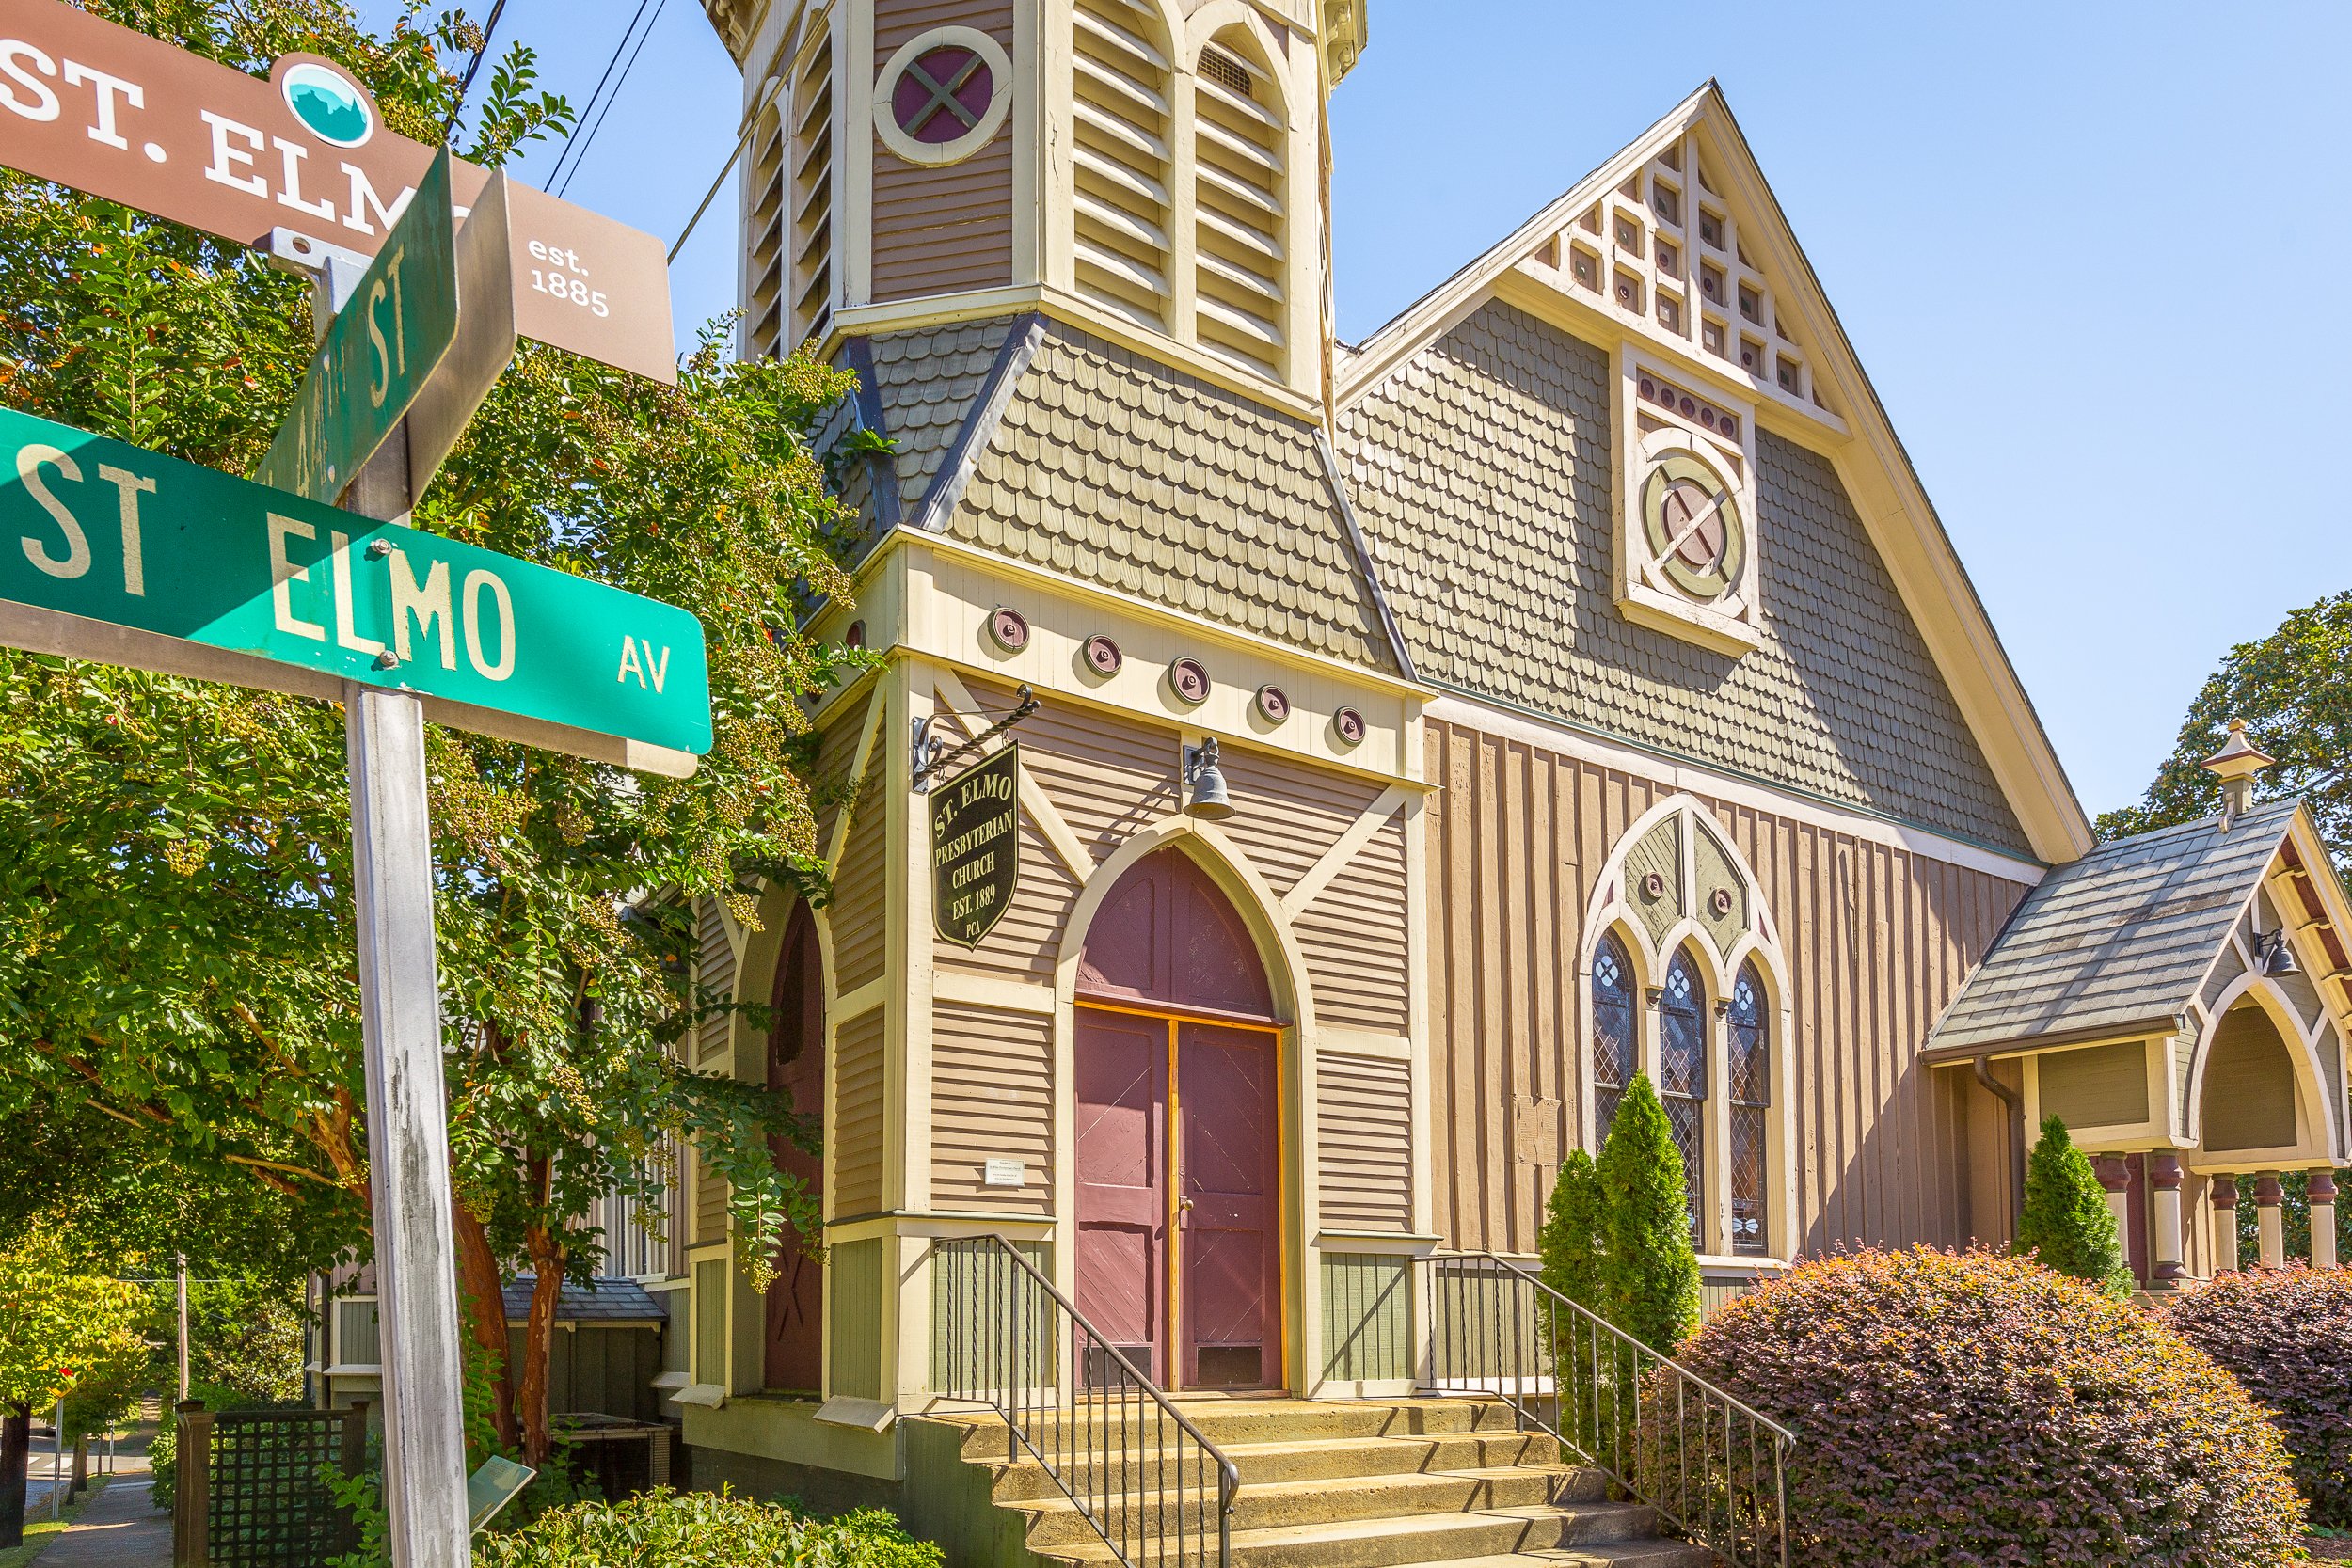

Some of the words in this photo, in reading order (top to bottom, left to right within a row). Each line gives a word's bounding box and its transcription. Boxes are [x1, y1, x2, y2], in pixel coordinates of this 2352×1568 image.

[0, 39, 167, 163] ST.
[200, 109, 471, 236] ELM
[528, 240, 589, 277] est.
[531, 269, 610, 318] 1885
[368, 241, 405, 408] ST
[16, 443, 156, 597] ST
[266, 512, 516, 682] ELMO
[617, 635, 670, 696] AV
[934, 798, 958, 840] ST.
[961, 773, 1012, 809] ELMO
[935, 809, 1013, 868] PRESBYTERIAN
[952, 850, 995, 890] CHURCH
[952, 895, 973, 921] EST.
[975, 883, 996, 911] 1889
[966, 920, 981, 939] PCA
